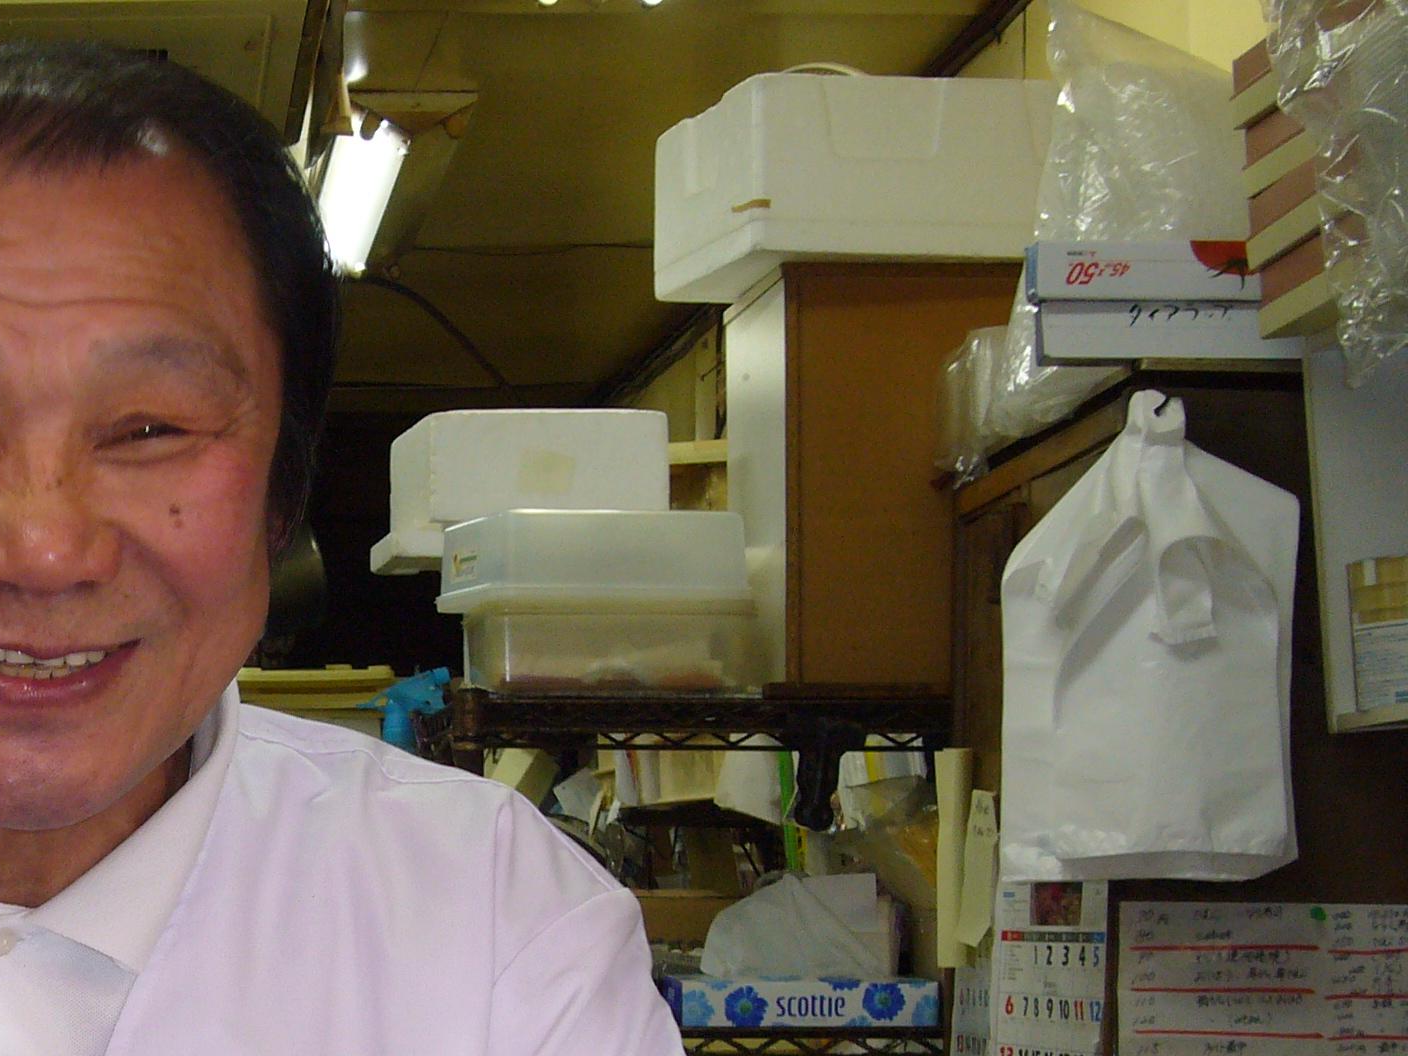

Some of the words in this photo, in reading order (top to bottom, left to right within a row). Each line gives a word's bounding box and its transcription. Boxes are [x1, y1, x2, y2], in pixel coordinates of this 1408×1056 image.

[1046, 945, 1052, 965] 2
[1062, 945, 1069, 966] 3
[1079, 946, 1085, 966] 4
[1093, 946, 1099, 967] 5
[776, 994, 846, 1018] scottie
[1005, 996, 1013, 1015] 6
[1024, 996, 1028, 1016] 7
[1034, 997, 1039, 1017] 8
[1047, 999, 1053, 1018] 9
[1059, 1000, 1069, 1019] 10
[1074, 1000, 1084, 1021] 11
[1090, 1001, 1101, 1022] 12
